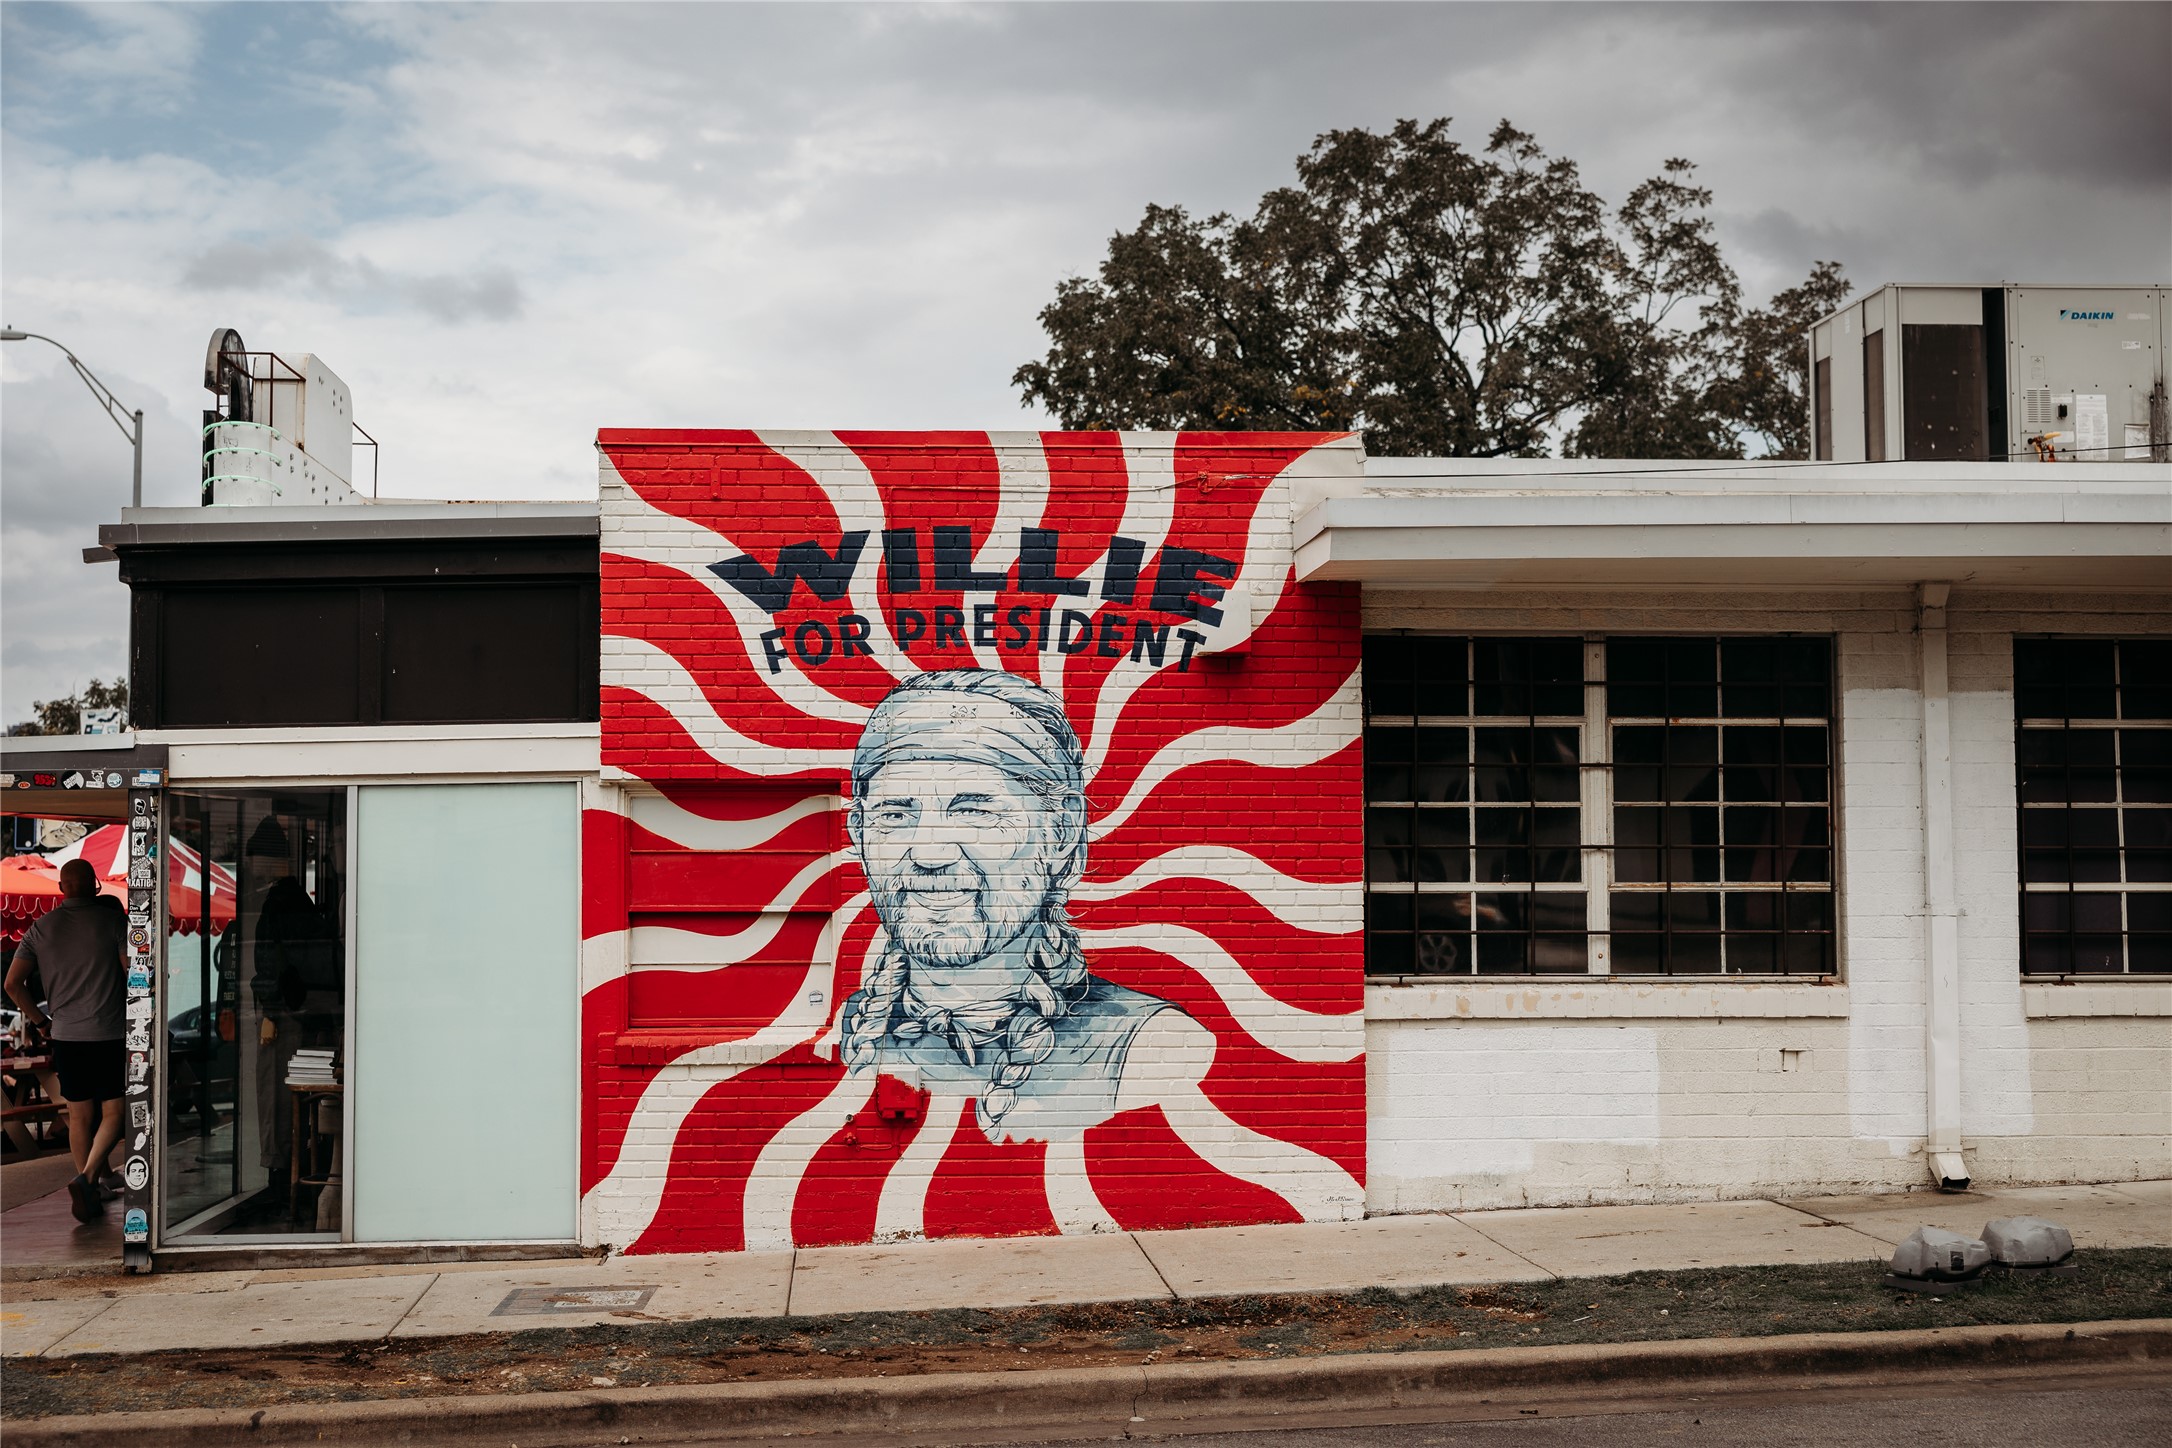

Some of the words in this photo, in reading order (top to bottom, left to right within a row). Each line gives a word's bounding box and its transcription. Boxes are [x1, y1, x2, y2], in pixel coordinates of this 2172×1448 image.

[2071, 312, 2114, 320] DAIKIN
[706, 525, 1238, 628] WILLIE
[760, 614, 875, 675] FOR
[897, 603, 1207, 673] PRESIDENT
